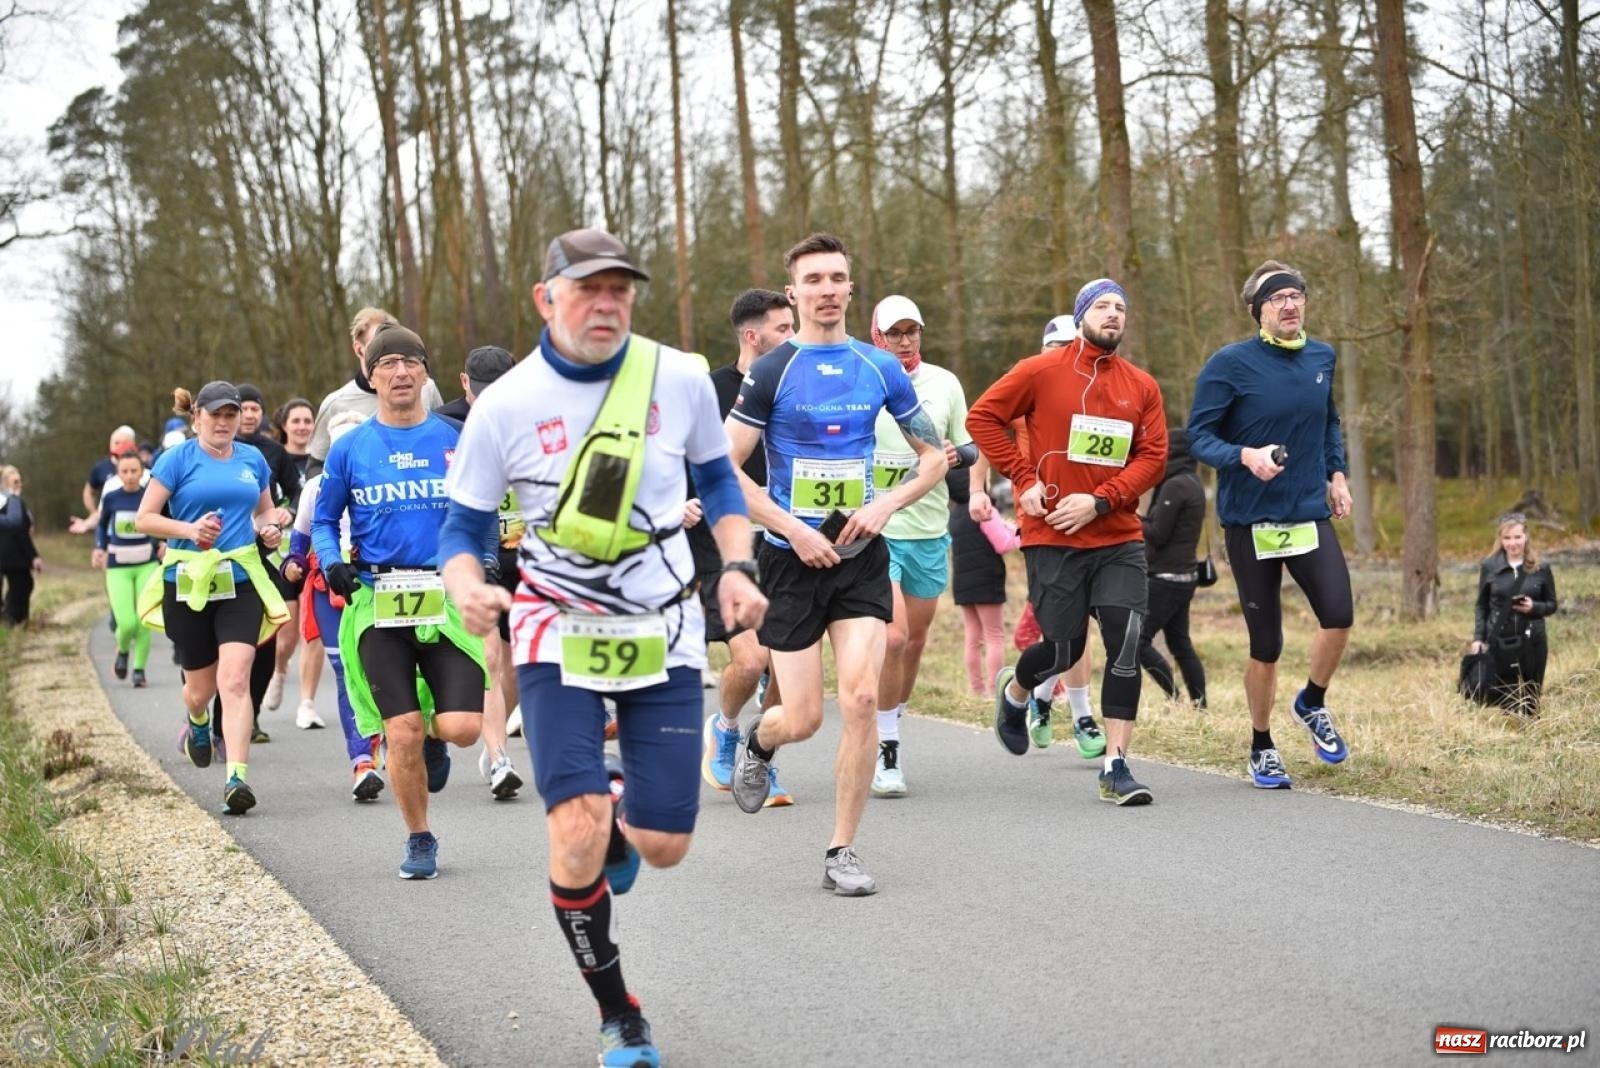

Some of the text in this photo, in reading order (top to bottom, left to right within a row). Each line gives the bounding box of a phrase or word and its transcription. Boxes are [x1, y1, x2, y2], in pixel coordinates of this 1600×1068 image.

[1086, 434, 1114, 456] 28
[813, 482, 846, 506] 31
[1277, 531, 1292, 548] 2
[393, 592, 425, 616] 17
[589, 640, 639, 675] 59
